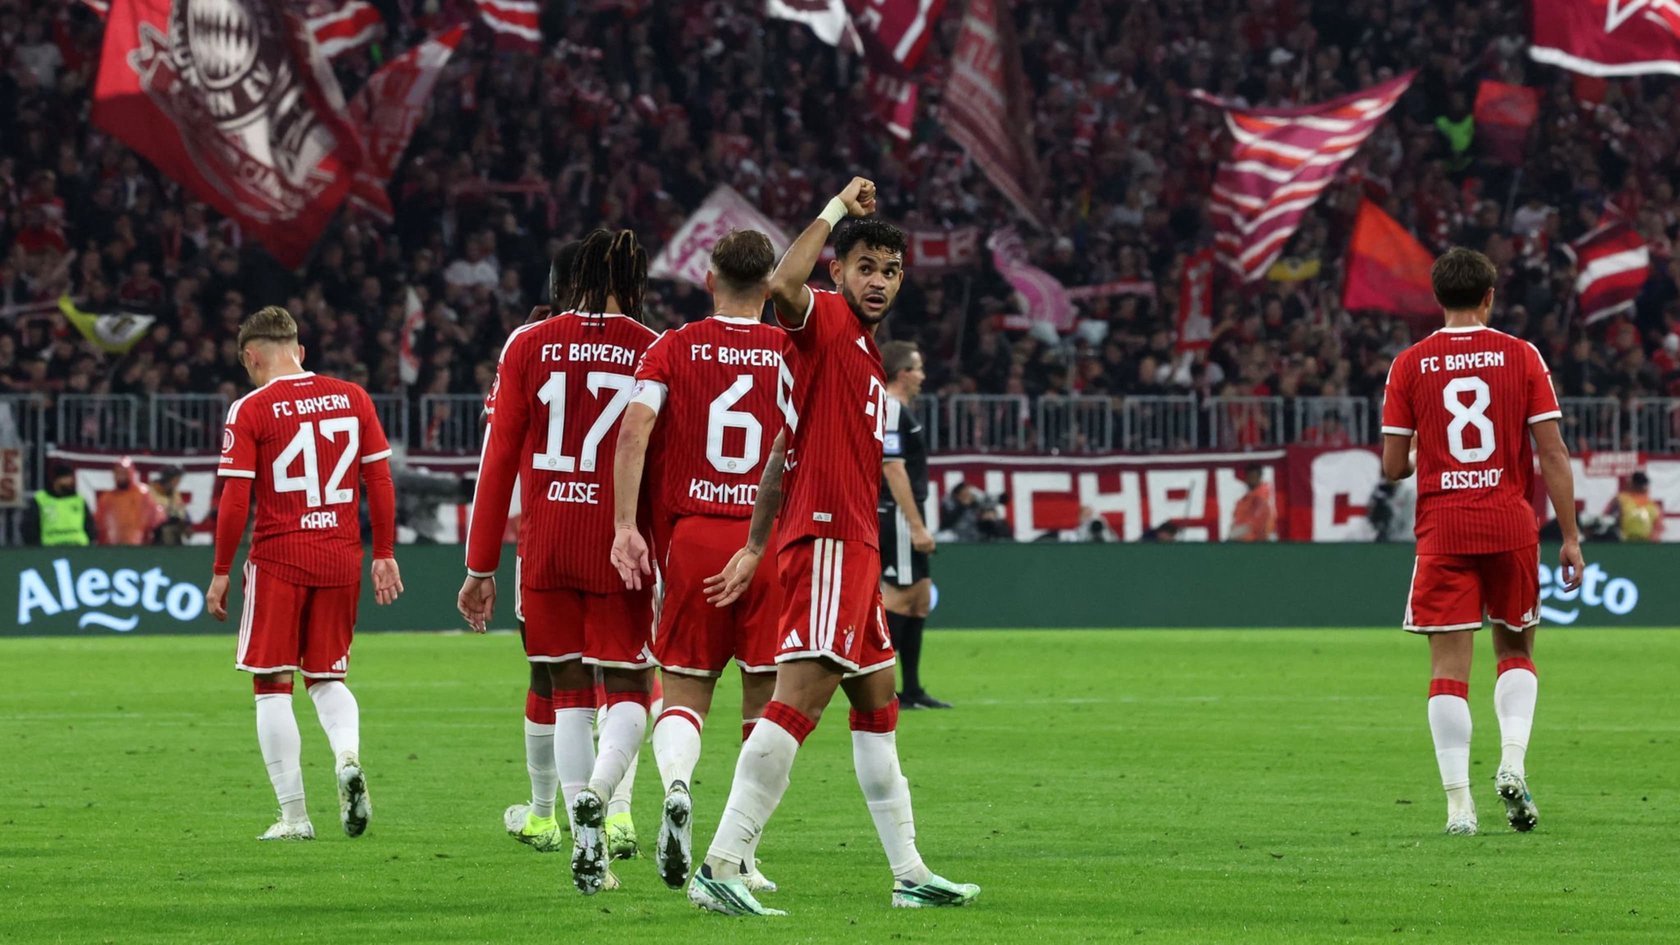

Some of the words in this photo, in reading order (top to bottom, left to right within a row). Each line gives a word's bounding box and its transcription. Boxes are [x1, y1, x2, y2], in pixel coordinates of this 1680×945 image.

[541, 343, 563, 363] FC
[568, 343, 636, 367] BAYERN
[691, 343, 712, 361] FC
[718, 346, 782, 367] BAYERN
[1420, 356, 1440, 374] FC
[1444, 351, 1505, 371] BAYERN
[272, 401, 293, 419] FC
[294, 394, 351, 415] BAYERN
[532, 371, 636, 473] 17
[705, 374, 763, 475] 6
[1442, 375, 1496, 464] 8
[272, 416, 360, 508] 42
[688, 478, 758, 505] KIMMIC
[1440, 468, 1504, 490] BISCHO
[547, 480, 600, 505] OLISE
[300, 510, 339, 530] KARL
[17, 558, 204, 626] Alesto
